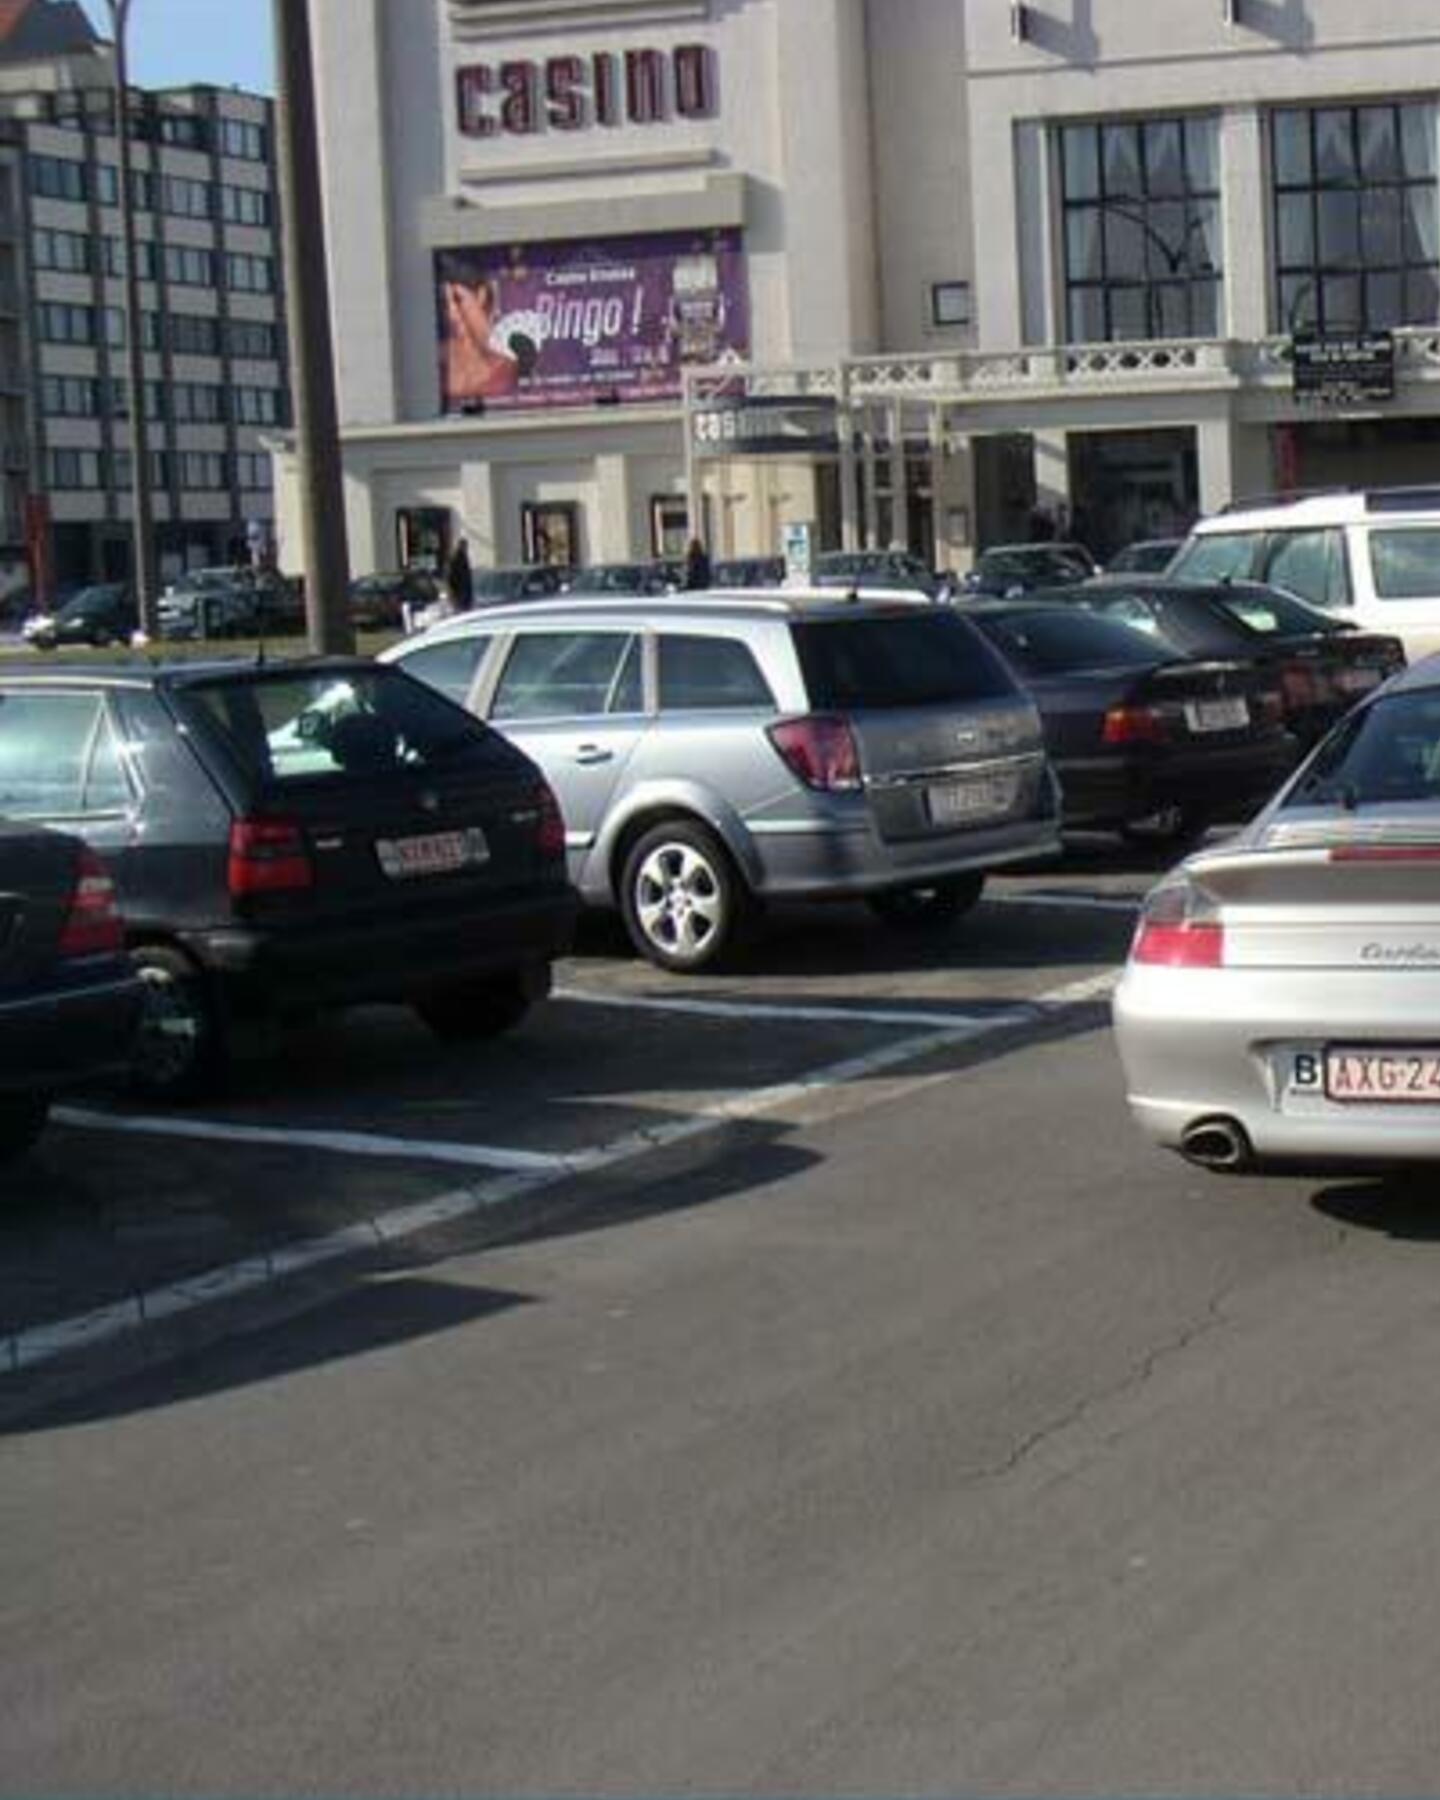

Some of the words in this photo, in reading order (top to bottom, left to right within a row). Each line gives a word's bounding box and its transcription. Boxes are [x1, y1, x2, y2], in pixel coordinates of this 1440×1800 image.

[456, 44, 714, 138] casino
[535, 291, 621, 345] Bingo
[1294, 1053, 1319, 1085] B
